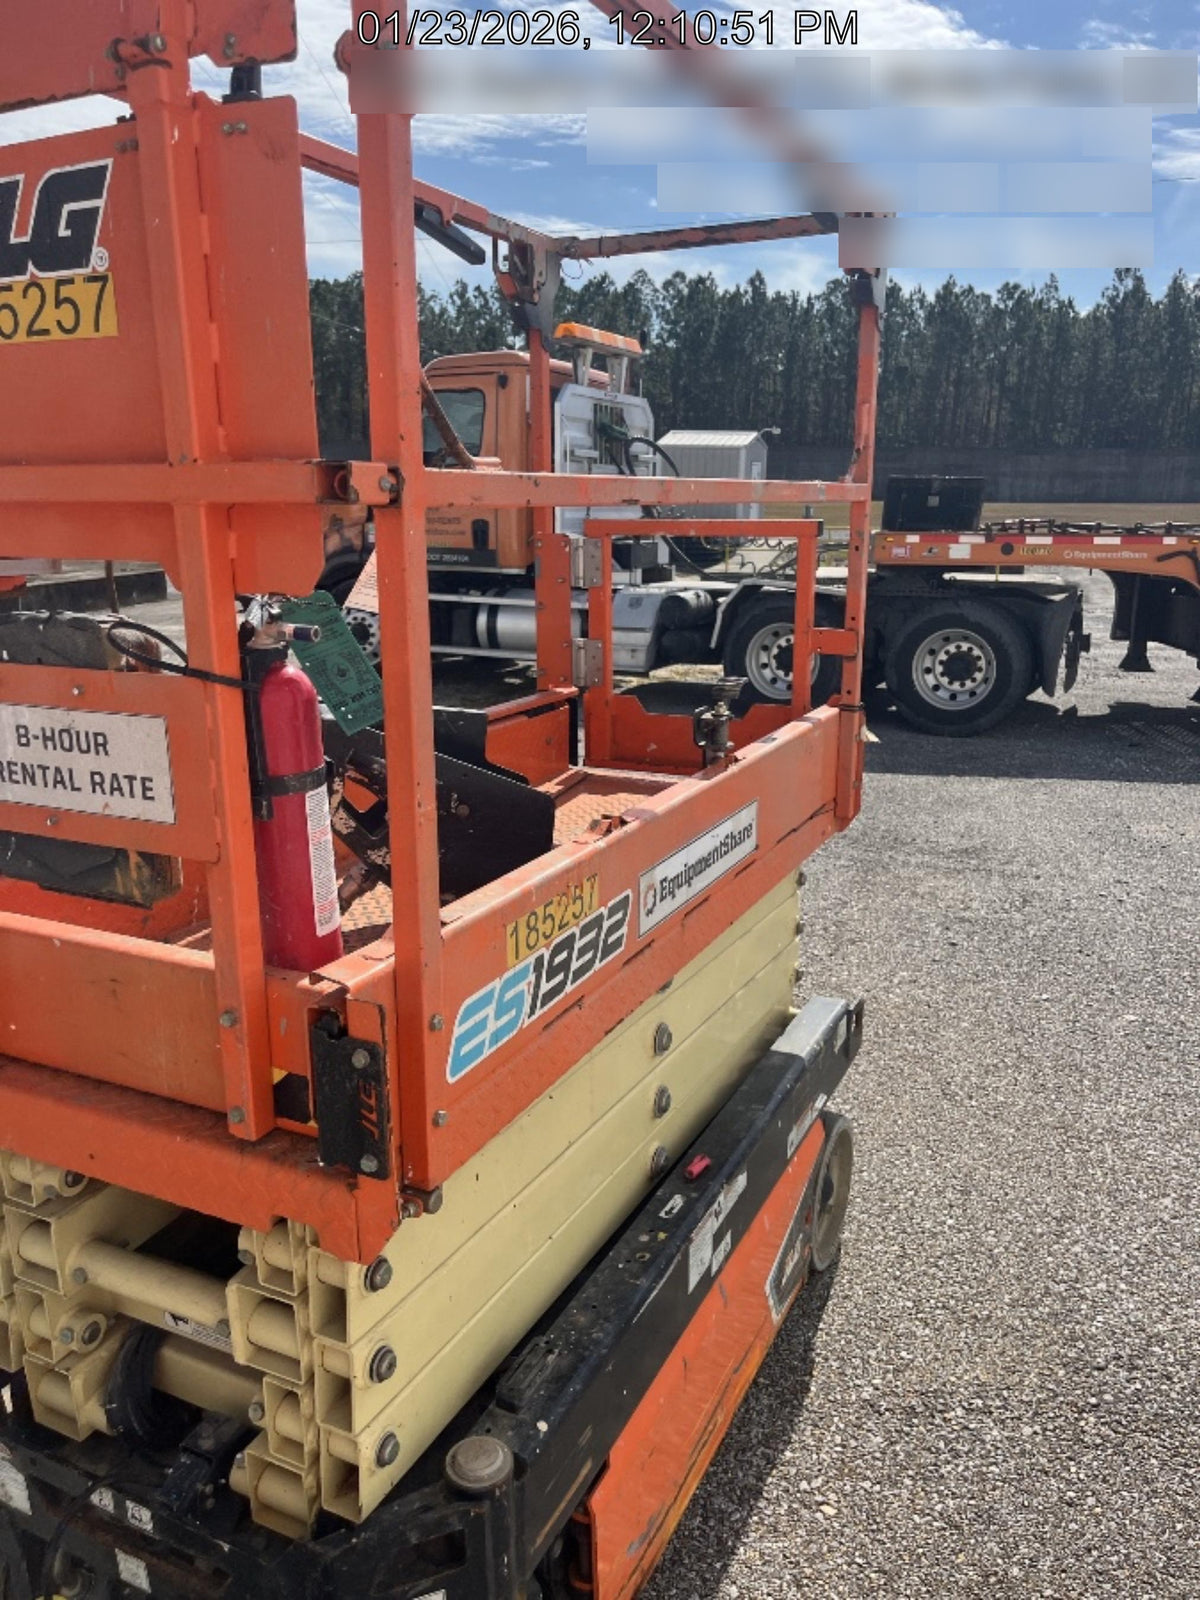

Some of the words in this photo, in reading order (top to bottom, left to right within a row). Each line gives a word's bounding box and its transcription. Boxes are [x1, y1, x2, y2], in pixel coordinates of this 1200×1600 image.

[15, 724, 110, 757] 8-HOUR
[90, 771, 156, 801] RATE
[659, 822, 753, 903] EquipmentShare
[509, 873, 598, 961] 185257
